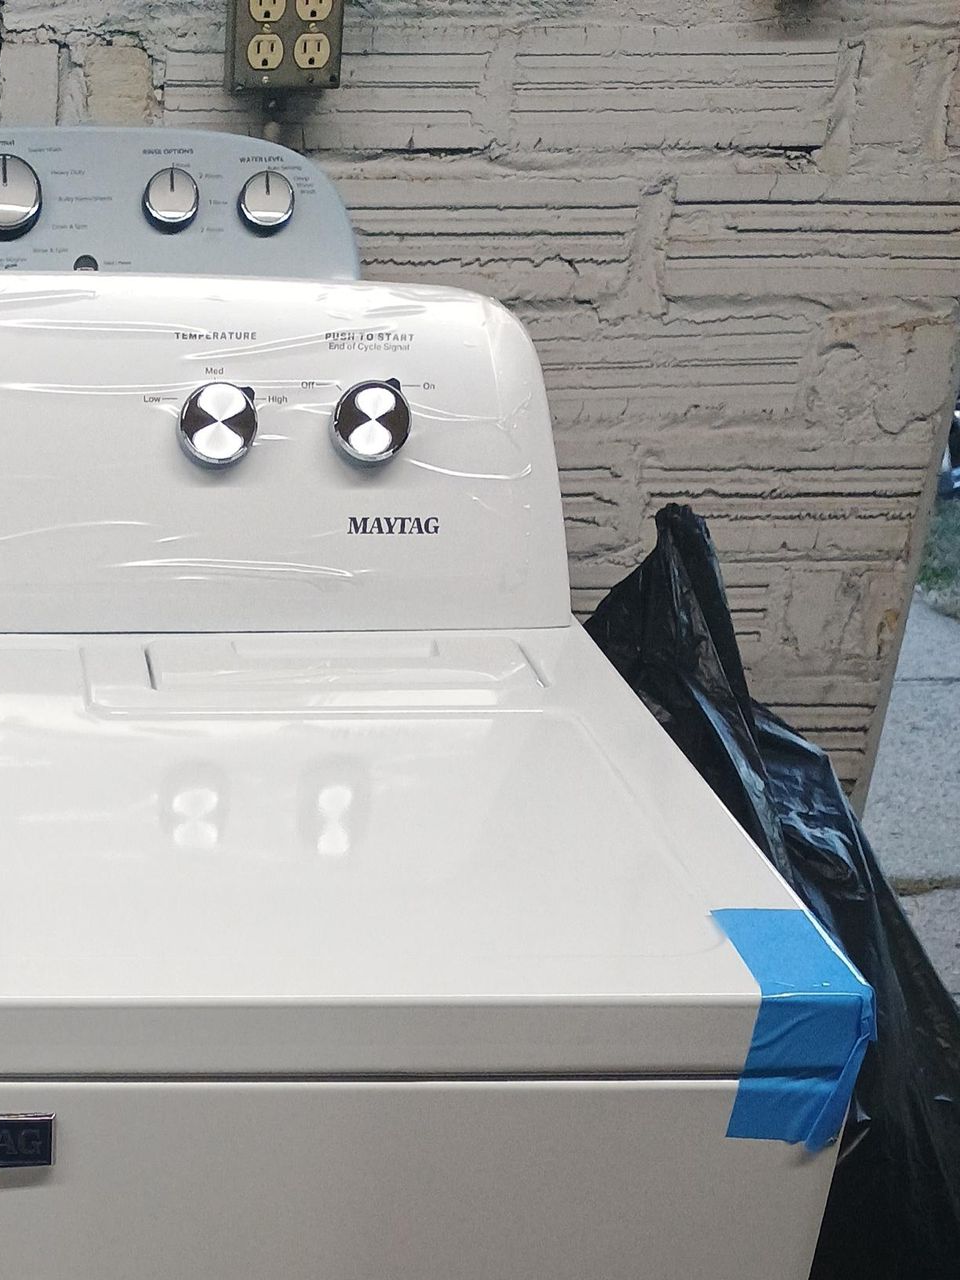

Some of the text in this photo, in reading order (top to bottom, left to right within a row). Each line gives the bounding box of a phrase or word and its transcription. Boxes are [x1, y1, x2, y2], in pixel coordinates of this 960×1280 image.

[239, 156, 264, 164] WATER
[174, 331, 258, 341] TEMPERATURE
[324, 331, 415, 342] PUSH TO START
[328, 342, 411, 353] End of Cycle Signal
[204, 366, 225, 375] Med
[300, 381, 316, 390] Off
[422, 381, 437, 391] On
[143, 395, 162, 404] Low
[268, 395, 289, 405] High
[346, 516, 441, 536] MAYTAG
